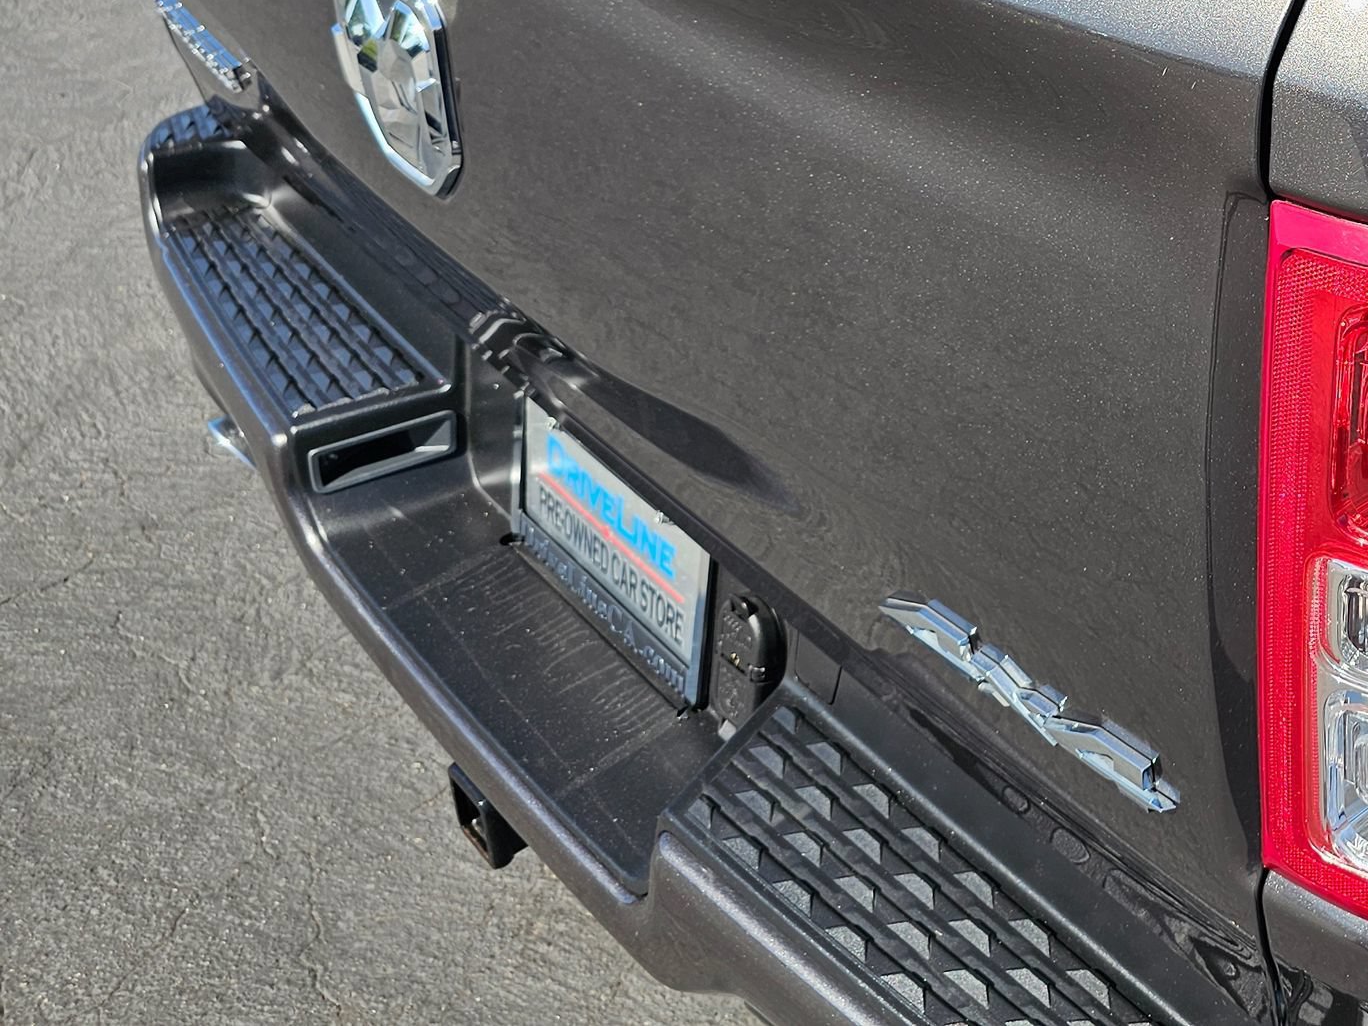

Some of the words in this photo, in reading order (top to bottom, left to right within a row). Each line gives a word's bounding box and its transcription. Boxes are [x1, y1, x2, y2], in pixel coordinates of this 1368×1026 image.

[539, 485, 609, 574] PRE-OWNED
[611, 551, 639, 603] CAR
[640, 578, 685, 645] STORE
